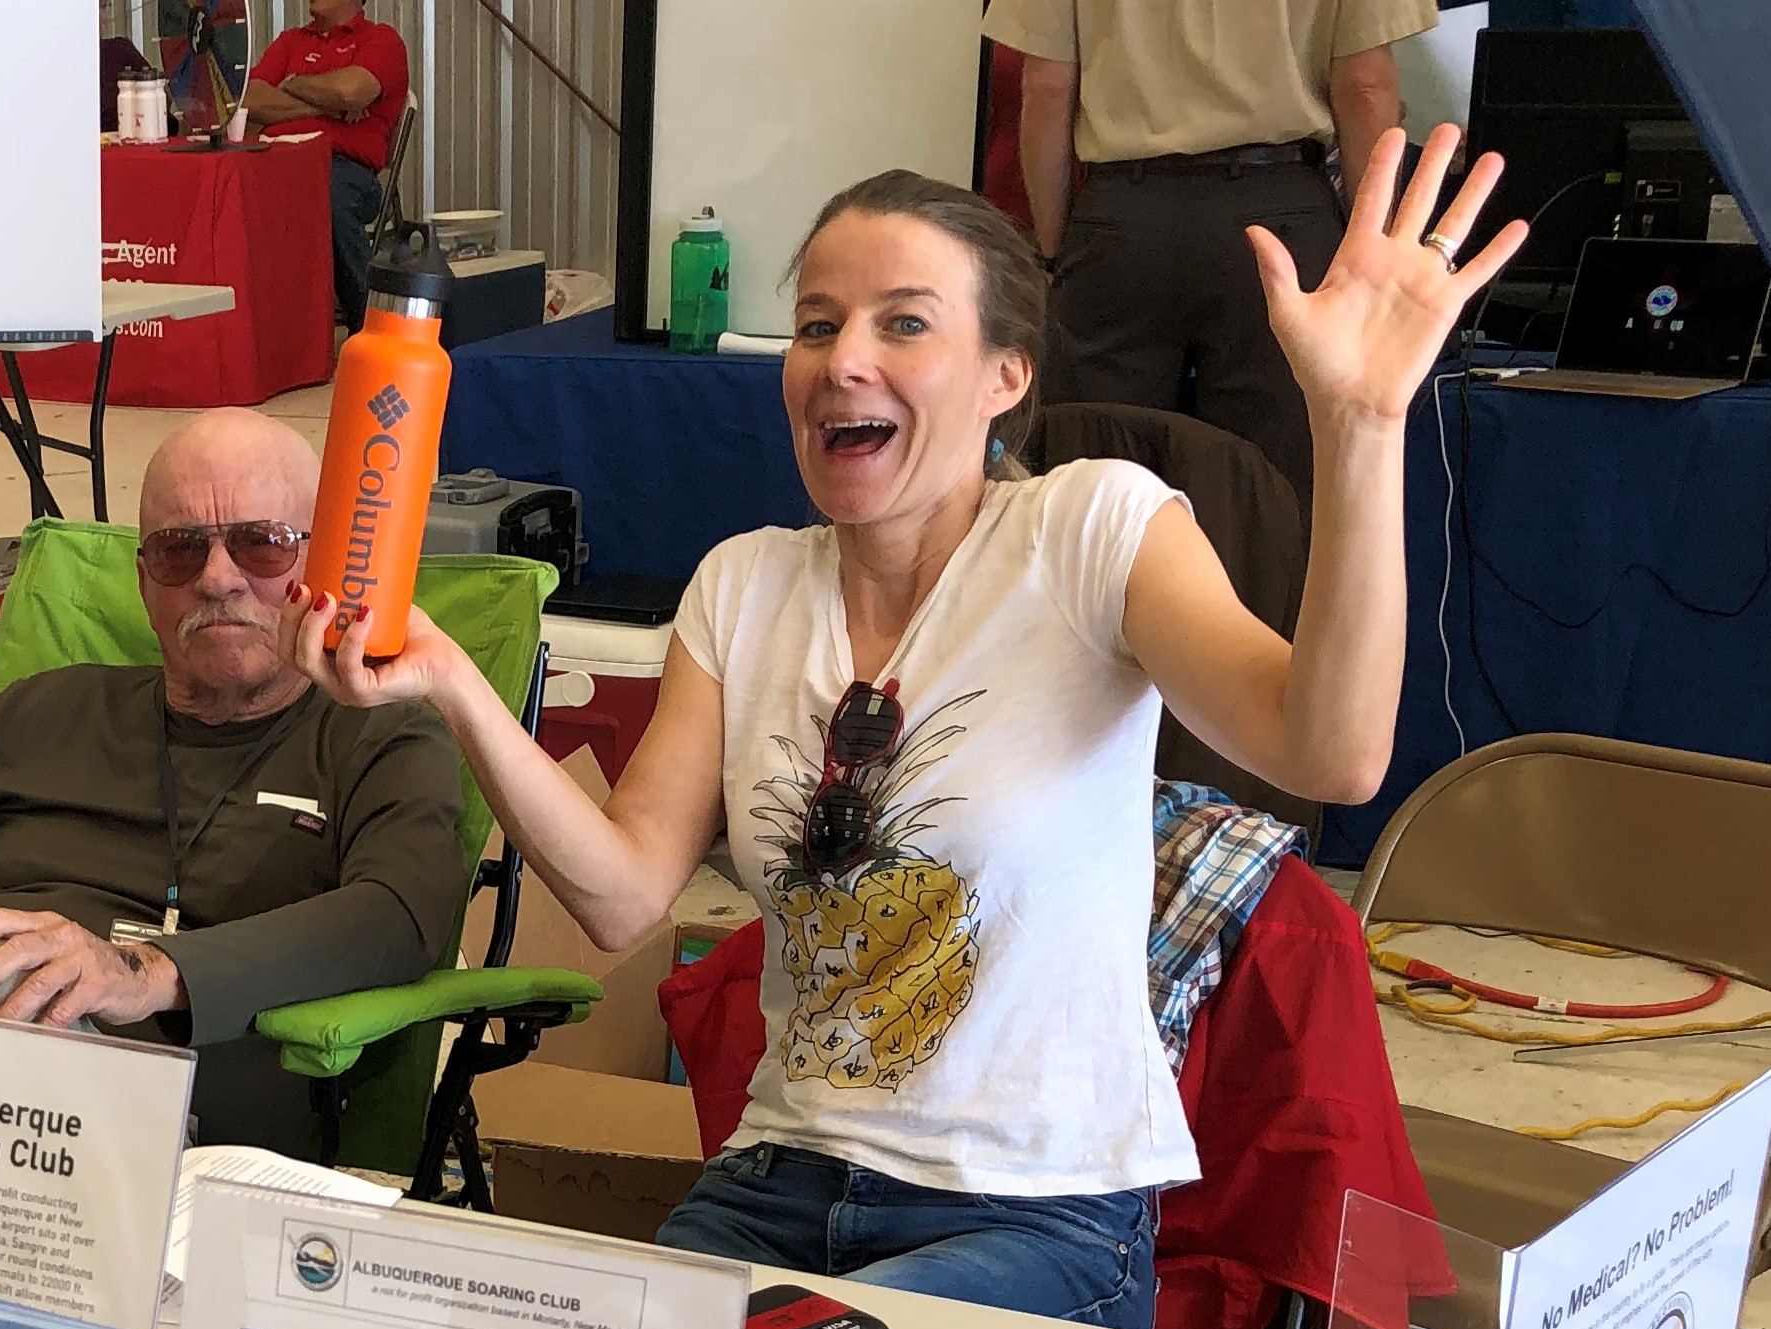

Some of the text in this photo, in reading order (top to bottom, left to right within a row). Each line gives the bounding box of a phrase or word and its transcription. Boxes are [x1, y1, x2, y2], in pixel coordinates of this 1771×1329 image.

[117, 239, 177, 268] Agent
[335, 433, 401, 632] Columbia
[9, 1137, 77, 1178] Club
[21, 1192, 78, 1214] conducting
[45, 1213, 57, 1223] at
[60, 1214, 84, 1229] New
[1566, 1241, 1641, 1320] Medical?
[1643, 1228, 1665, 1261] No
[1668, 1168, 1735, 1242] Problem!
[352, 1260, 581, 1312] ALBUQUERQUE SOARING CLUB
